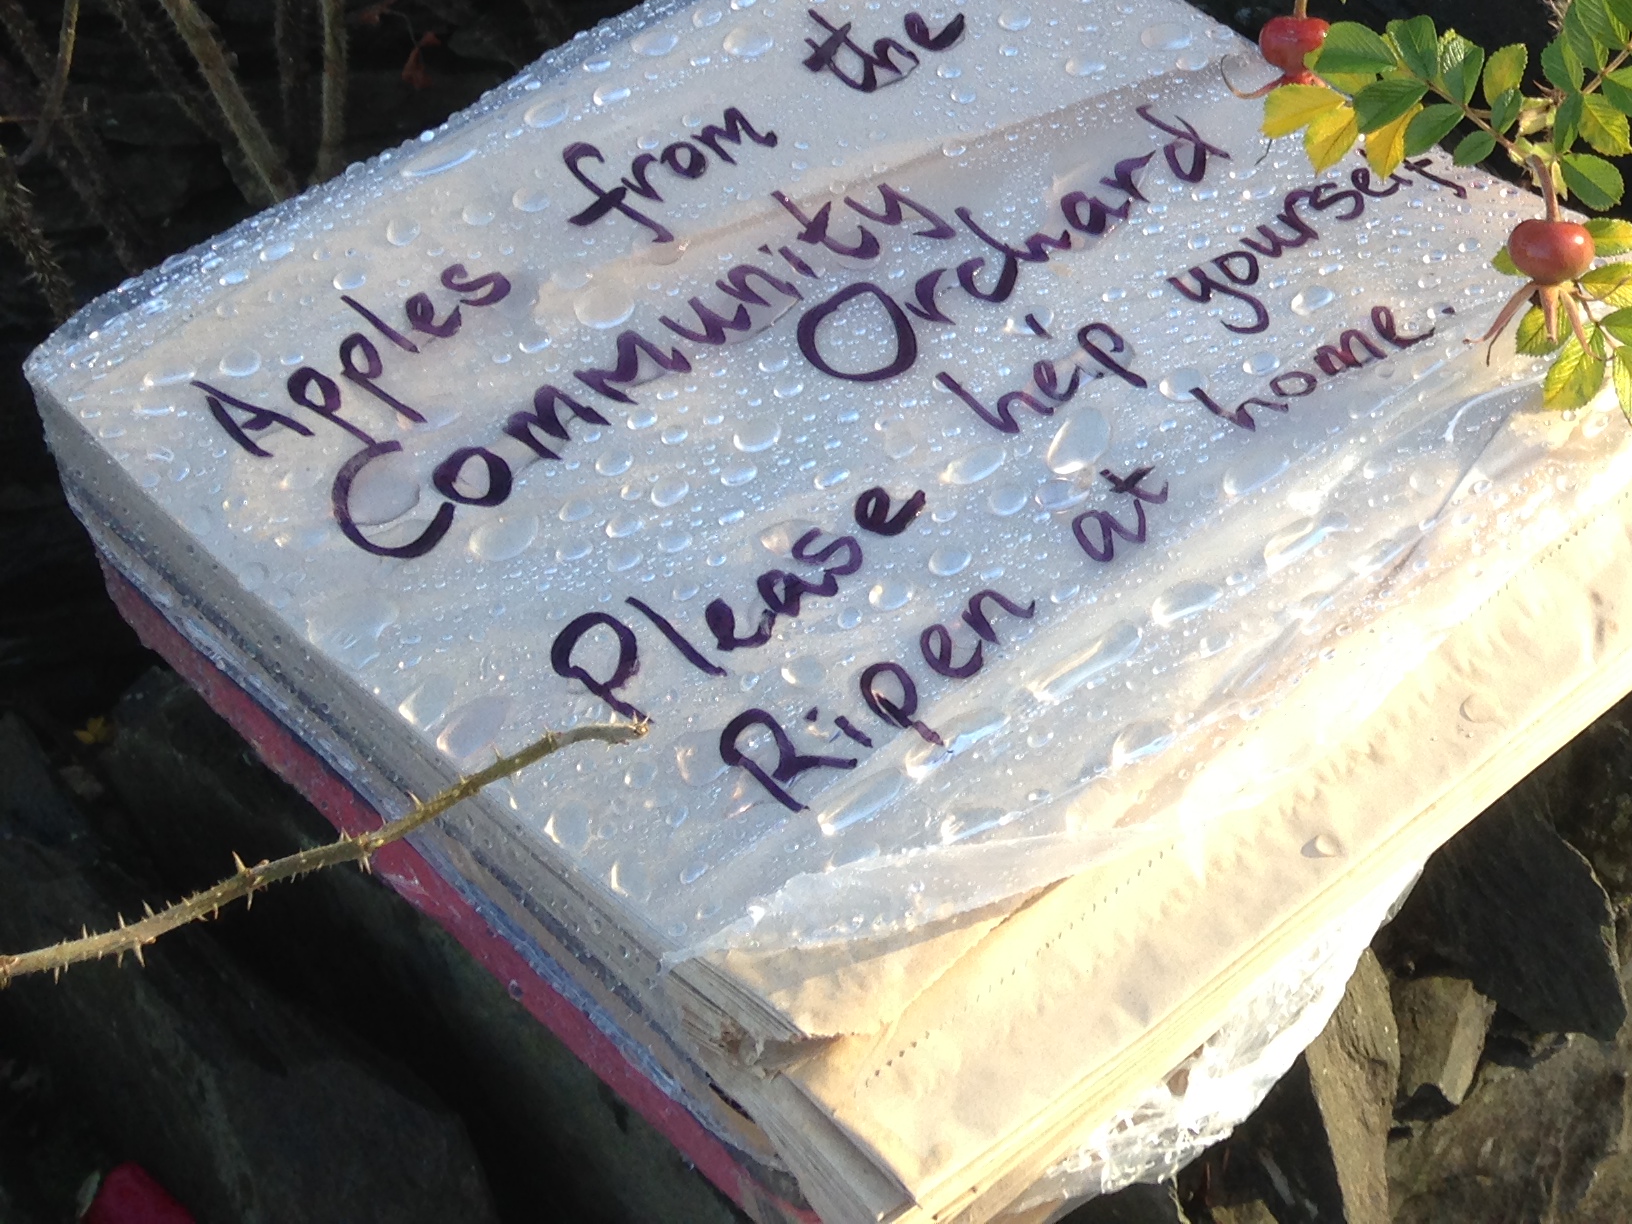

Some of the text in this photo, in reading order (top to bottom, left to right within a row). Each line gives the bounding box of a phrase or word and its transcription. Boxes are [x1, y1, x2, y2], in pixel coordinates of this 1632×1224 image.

[190, 9, 966, 458] Apples from the
[331, 105, 1232, 559] Community Orchard
[549, 486, 927, 725] Please
[719, 304, 1456, 812] Ripen at home.
